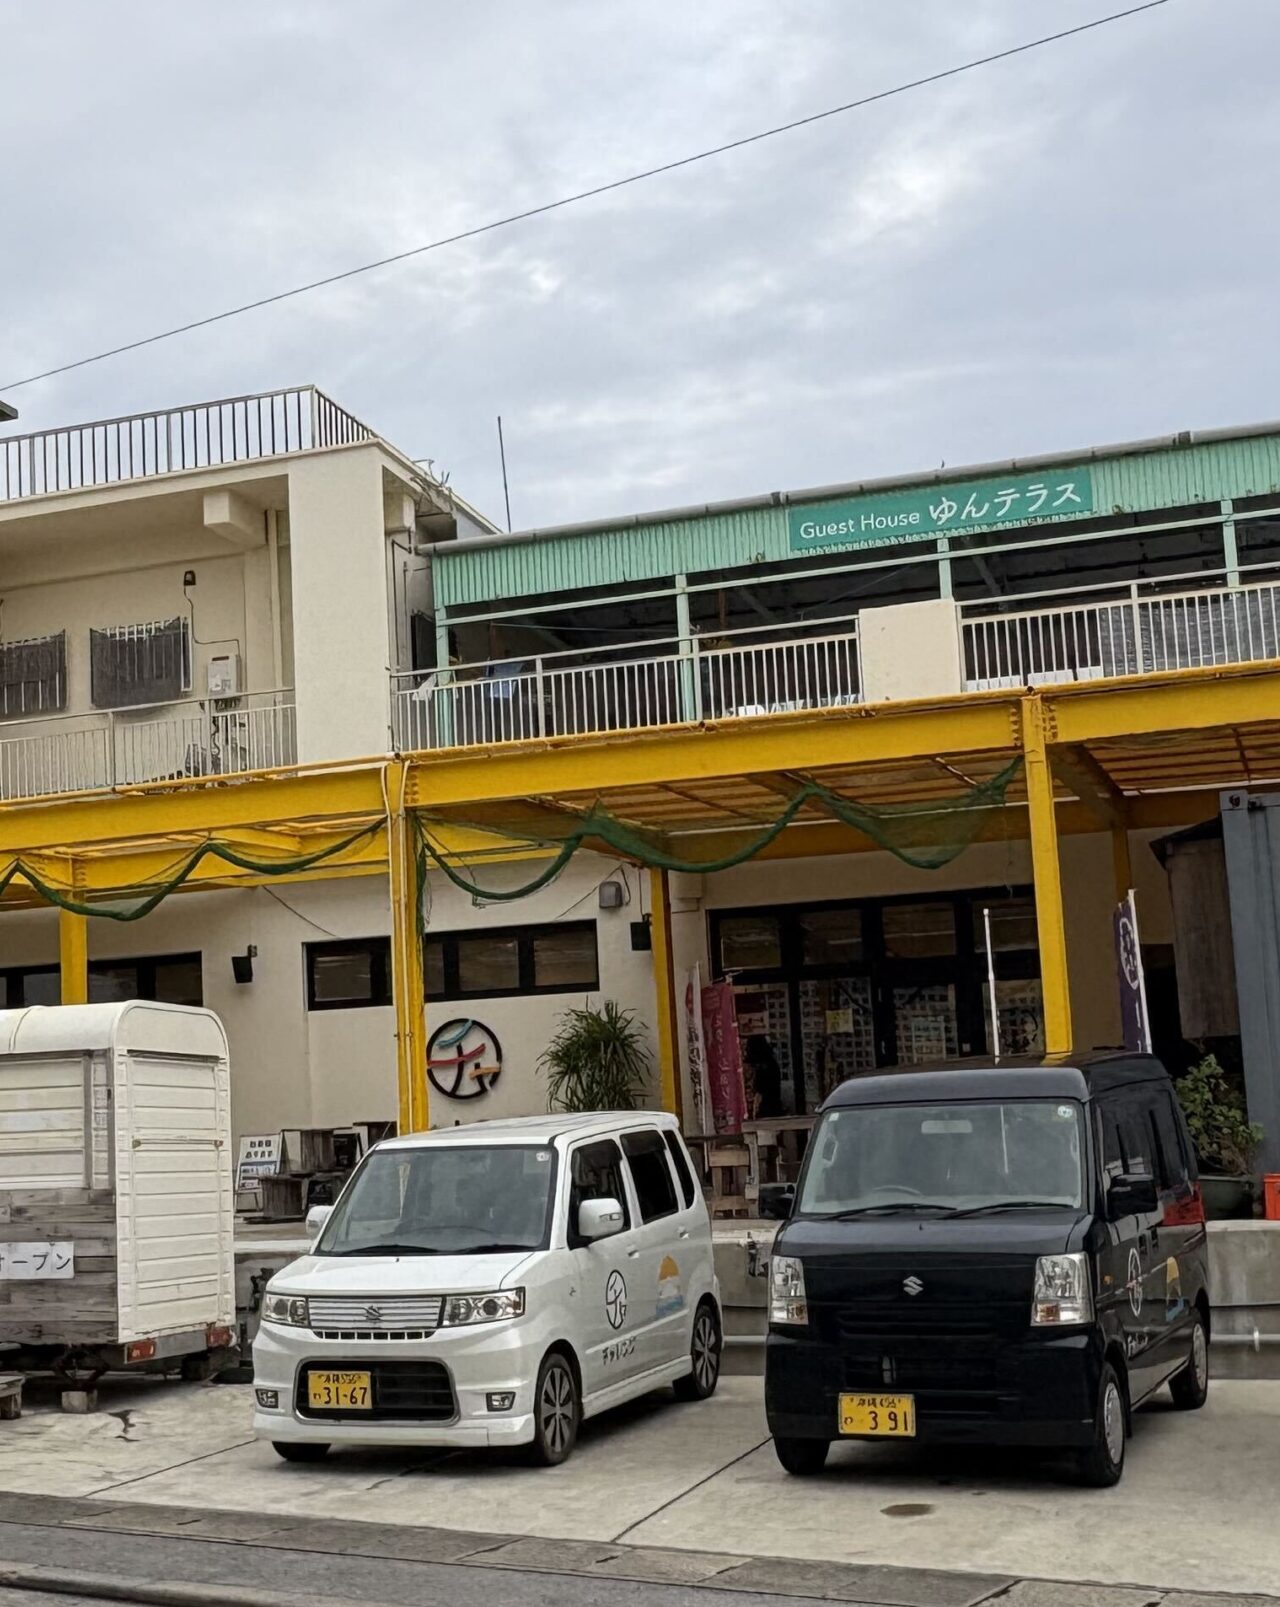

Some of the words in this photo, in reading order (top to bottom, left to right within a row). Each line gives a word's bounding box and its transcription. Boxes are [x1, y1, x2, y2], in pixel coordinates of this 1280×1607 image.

[800, 519, 854, 539] Guest
[861, 511, 920, 530] House
[929, 482, 1081, 525] ゆんテラス
[323, 1386, 368, 1405] 31-67
